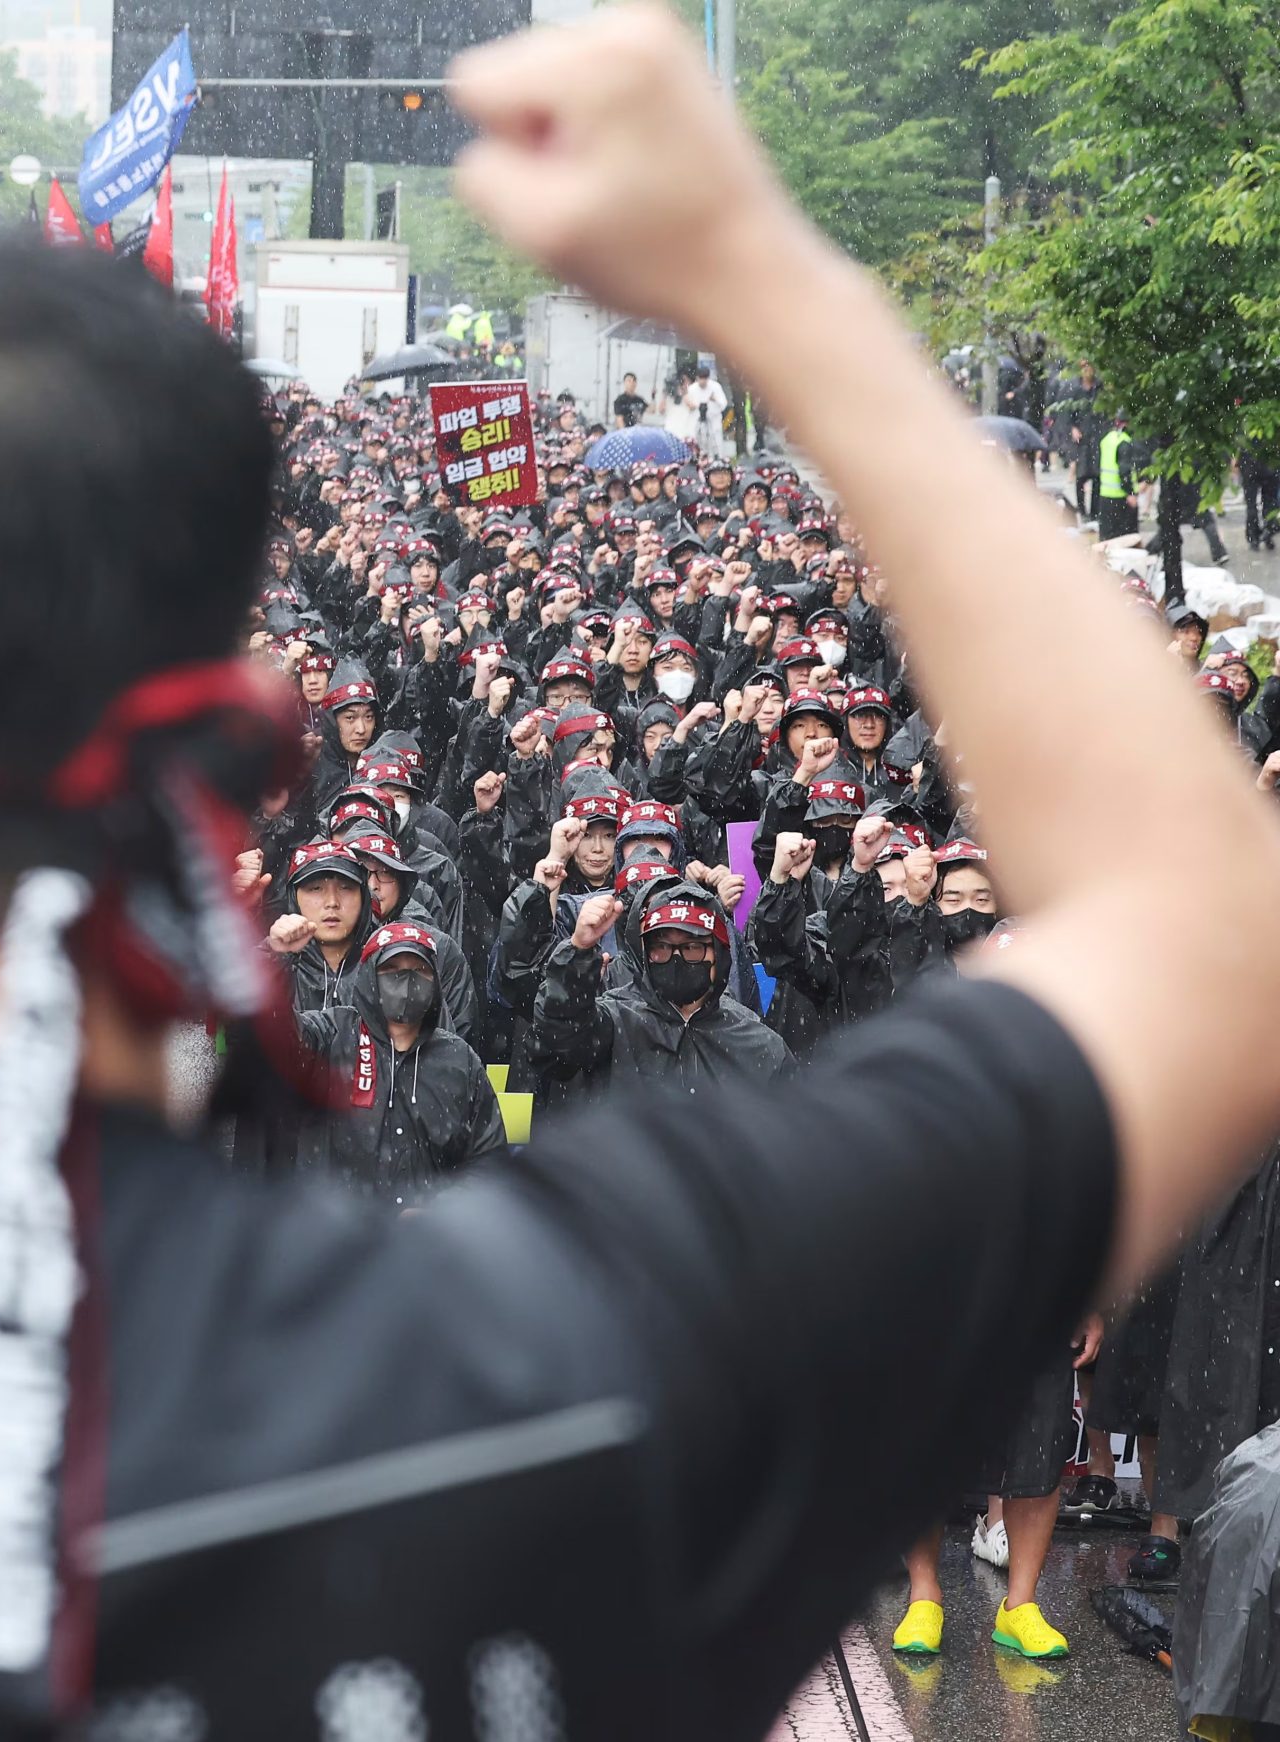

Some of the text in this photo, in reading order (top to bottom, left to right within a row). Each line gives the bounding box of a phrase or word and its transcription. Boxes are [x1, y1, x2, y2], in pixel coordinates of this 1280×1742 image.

[438, 393, 521, 434] 파업 투쟁
[460, 418, 511, 453] 승리!
[445, 444, 527, 484] 임금 협약
[467, 468, 520, 502] 쟁취!
[621, 806, 676, 825] 총파업
[648, 907, 714, 929] 총파업
[358, 1033, 372, 1091] NSEU
